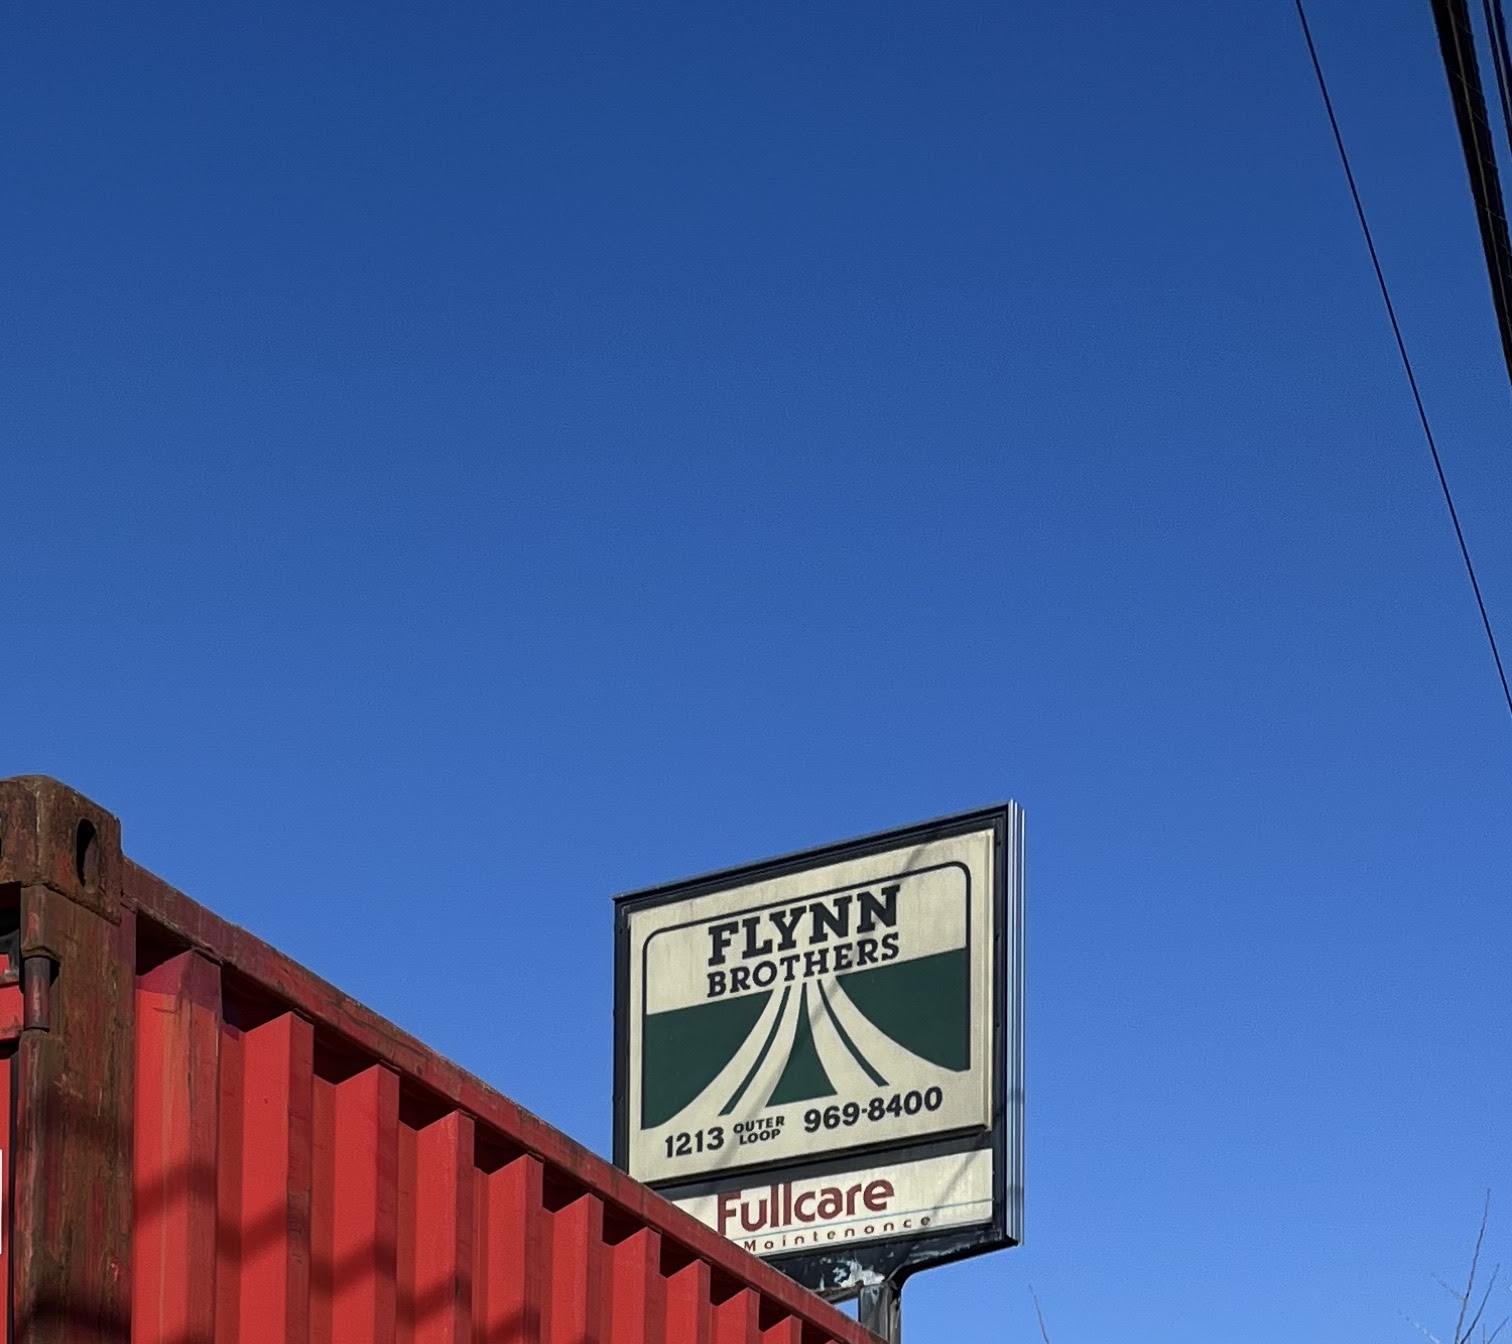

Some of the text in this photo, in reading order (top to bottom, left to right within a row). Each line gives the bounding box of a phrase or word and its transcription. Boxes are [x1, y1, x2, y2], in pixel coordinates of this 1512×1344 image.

[707, 884, 901, 967] FLYNN
[706, 931, 900, 998] BROTHERS
[732, 1115, 786, 1135] OUTER
[803, 1086, 944, 1133] 969-8400
[664, 1126, 725, 1158] 1213
[738, 1128, 781, 1146] LOOP
[716, 1178, 896, 1236] Fullcare
